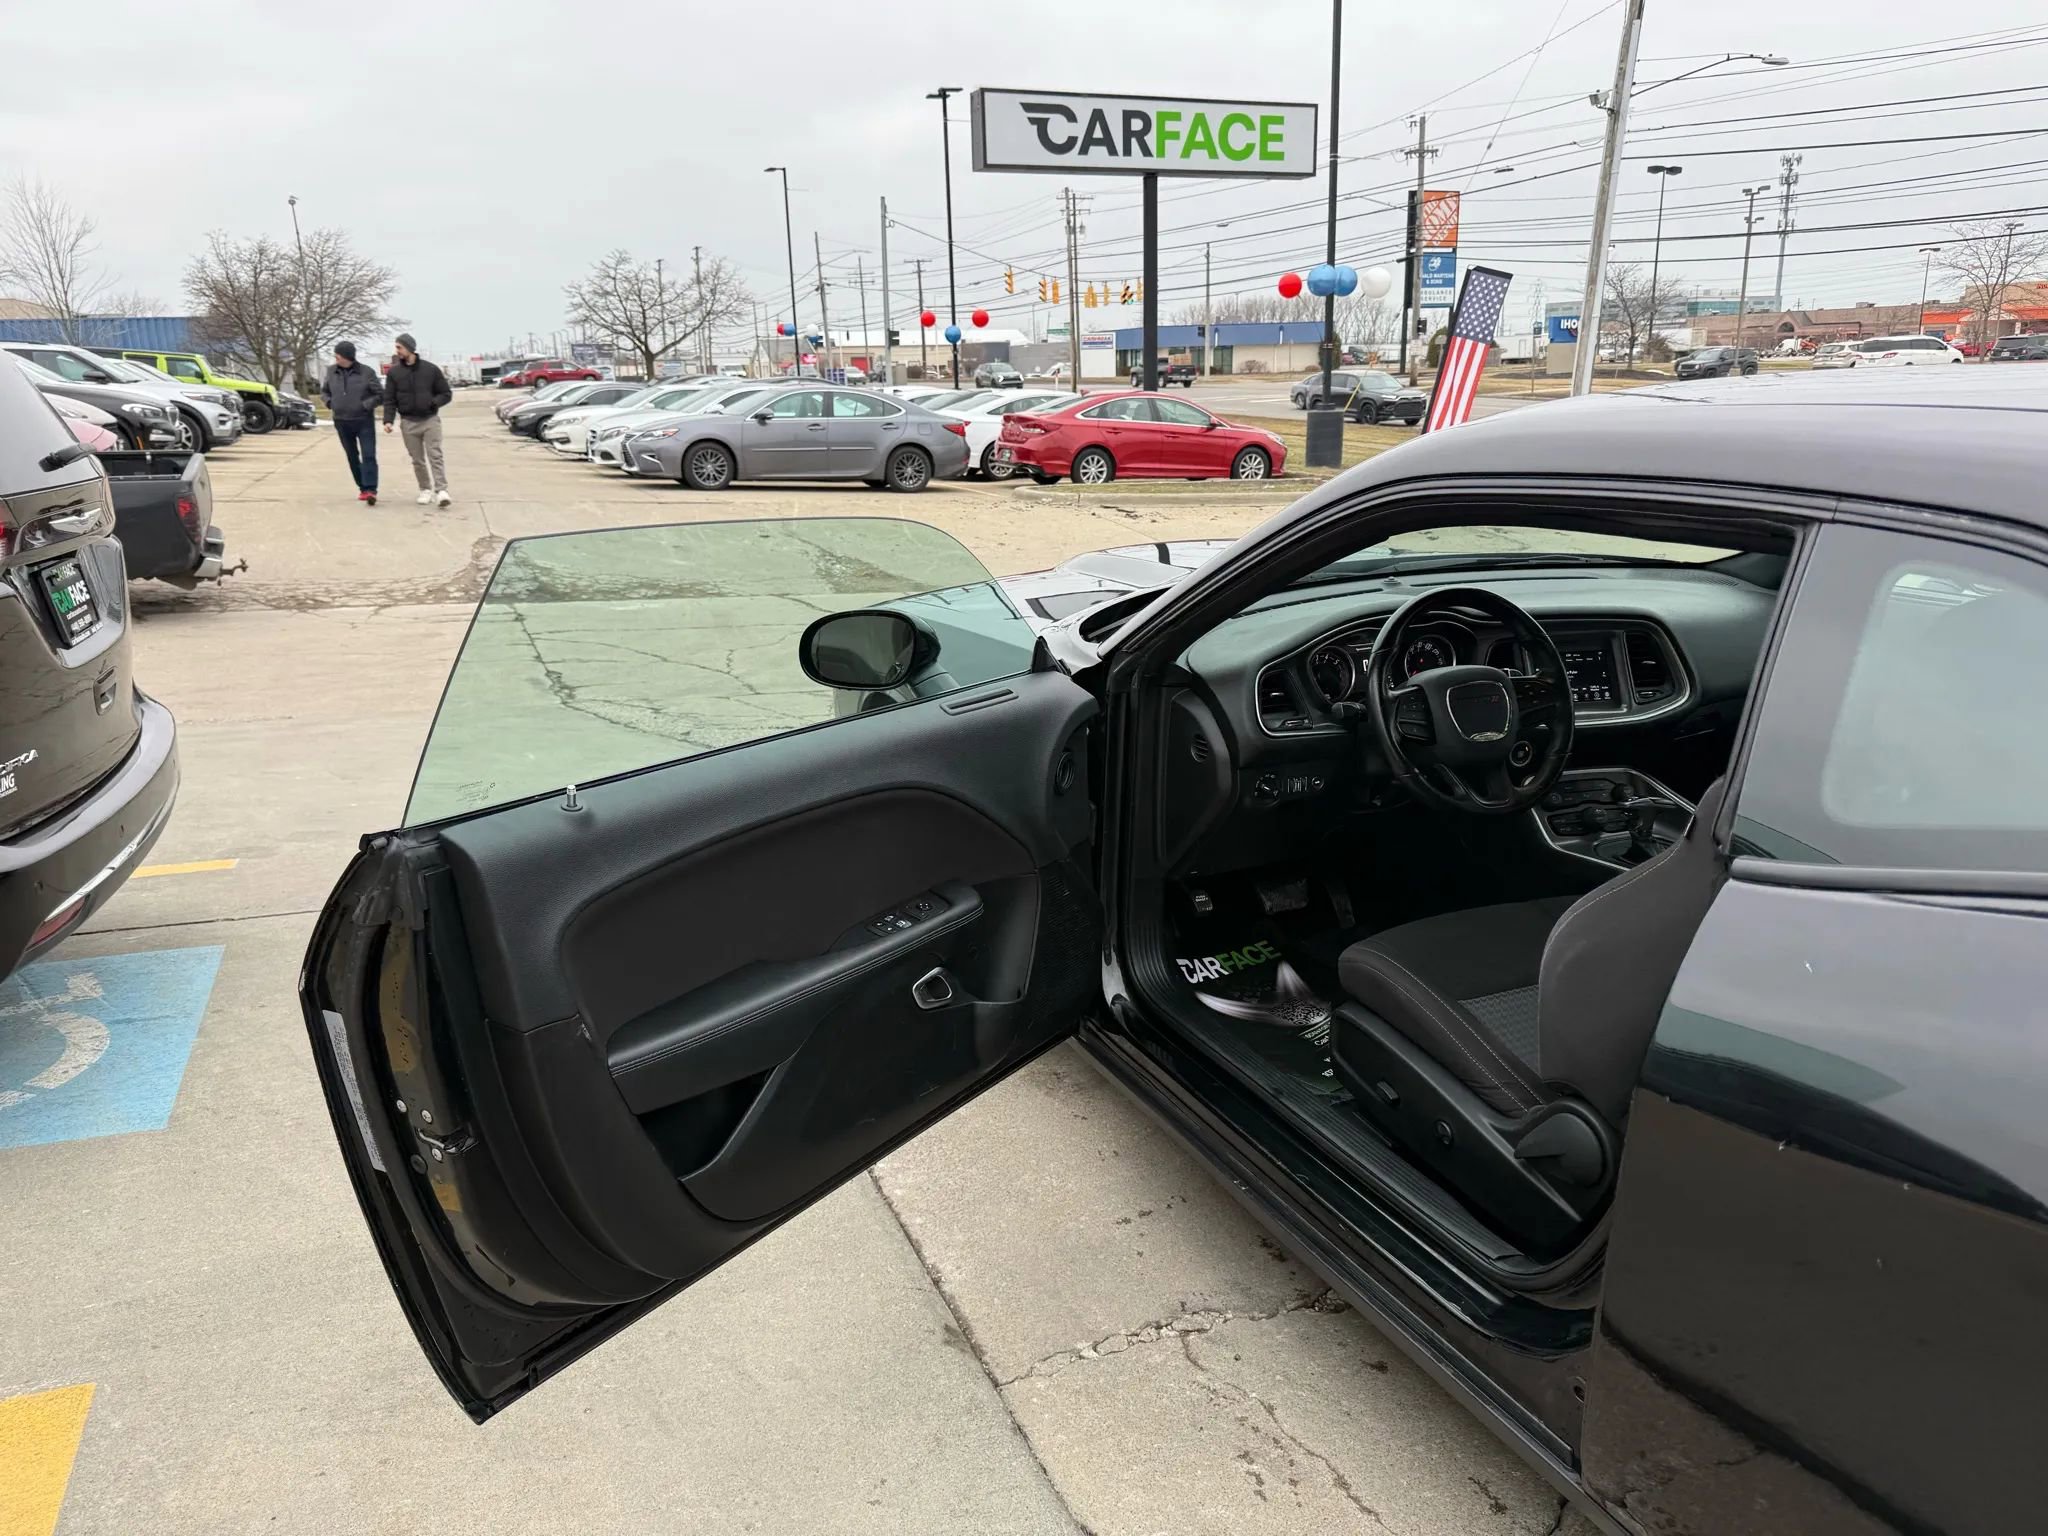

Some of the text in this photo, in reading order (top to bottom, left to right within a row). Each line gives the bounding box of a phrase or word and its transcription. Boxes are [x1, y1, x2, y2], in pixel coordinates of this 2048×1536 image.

[1020, 102, 1285, 162] CARFACE
[1560, 319, 1578, 329] IHO
[1176, 940, 1282, 984] CARFACE
